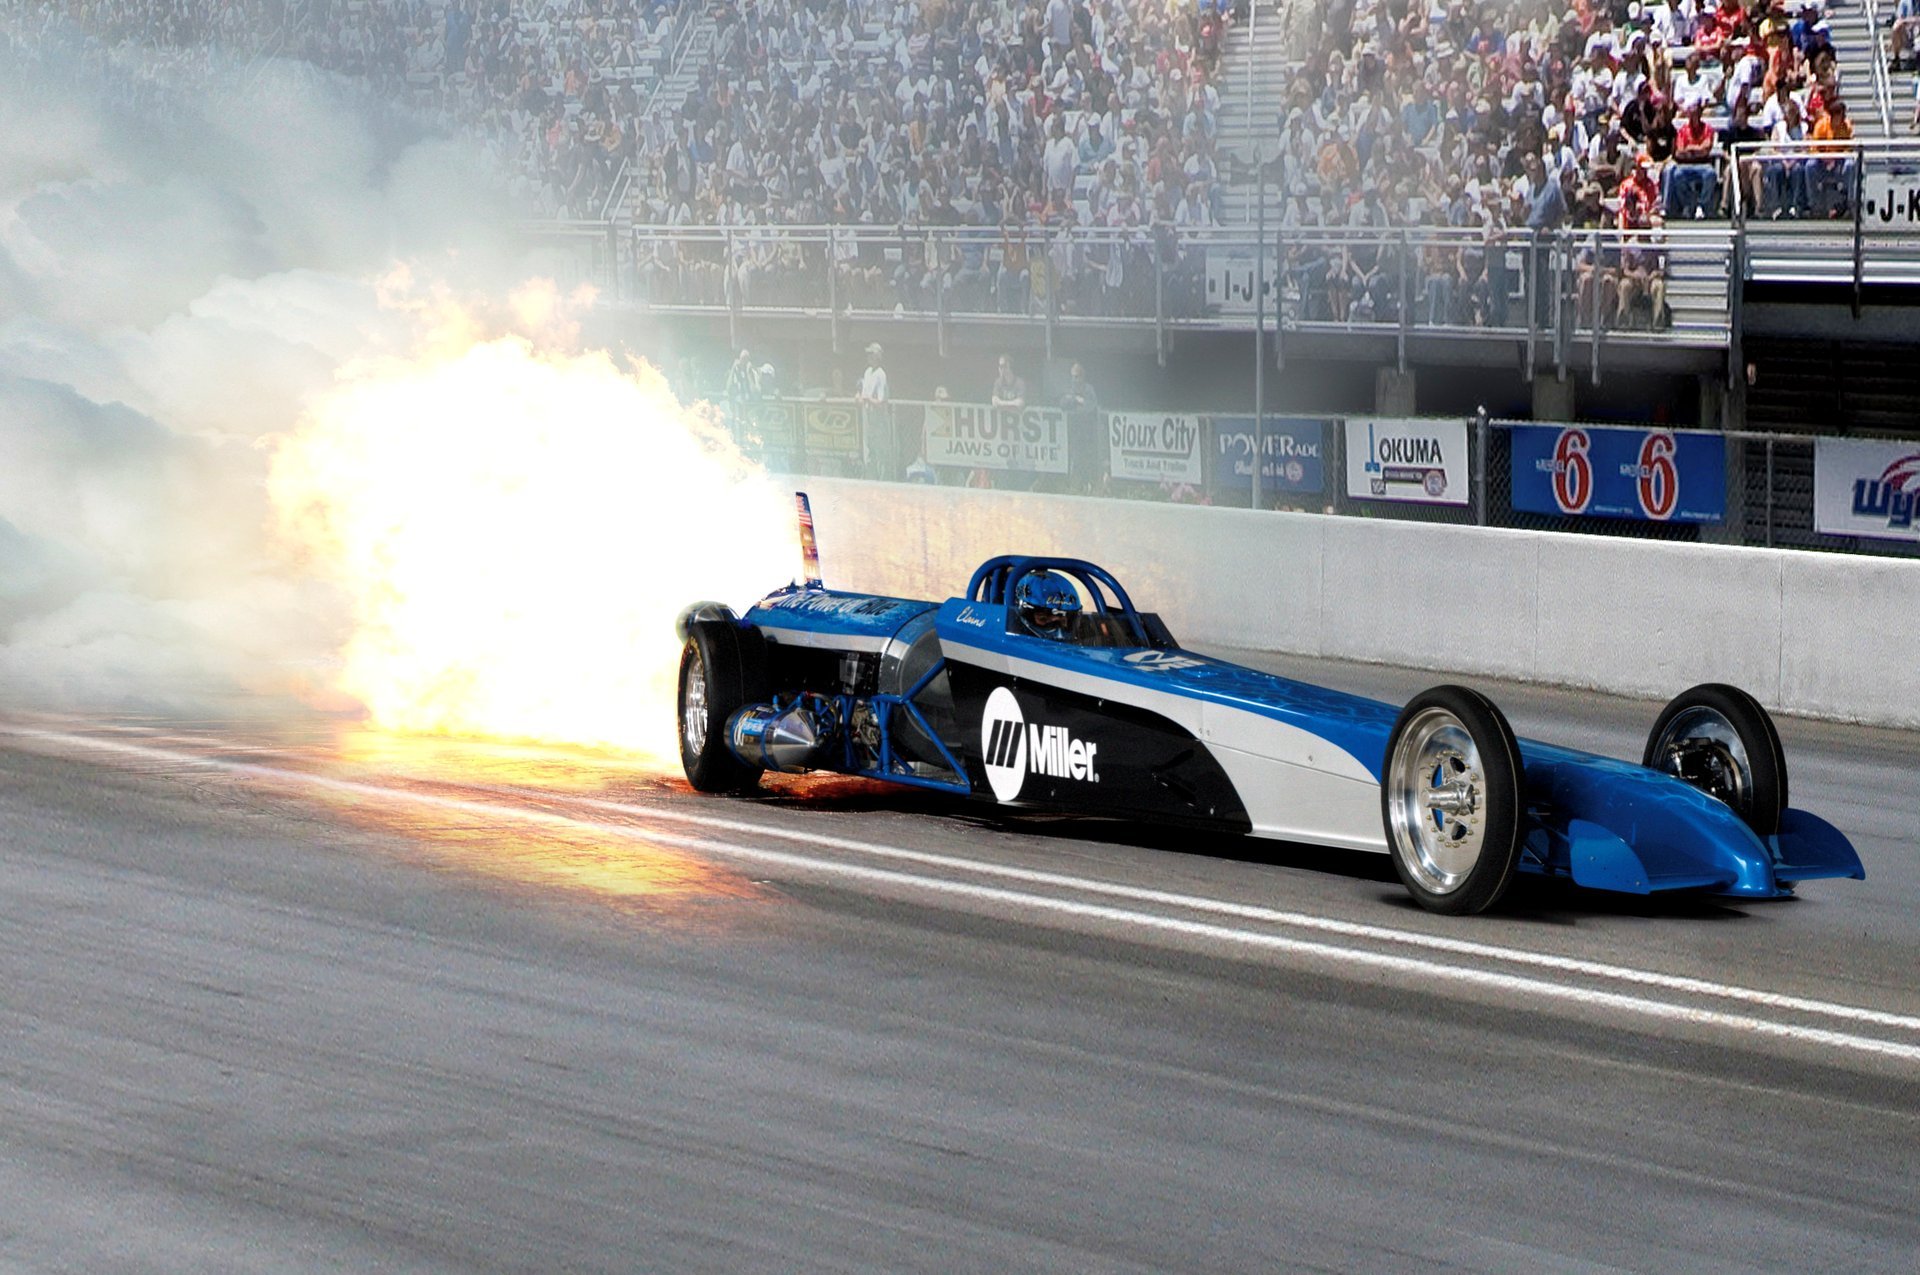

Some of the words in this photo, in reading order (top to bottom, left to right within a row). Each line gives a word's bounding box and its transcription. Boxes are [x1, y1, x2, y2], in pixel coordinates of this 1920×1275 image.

[953, 406, 1063, 444] HURST
[1112, 416, 1157, 450] Sioux
[1162, 417, 1196, 460] City
[945, 440, 993, 457] JAWS
[997, 443, 1020, 459] OF
[1025, 446, 1058, 462] LIFE
[1379, 438, 1443, 463] OKUMA
[1552, 427, 1593, 514] 6
[1637, 432, 1679, 520] 6
[1029, 723, 1098, 782] Miller
